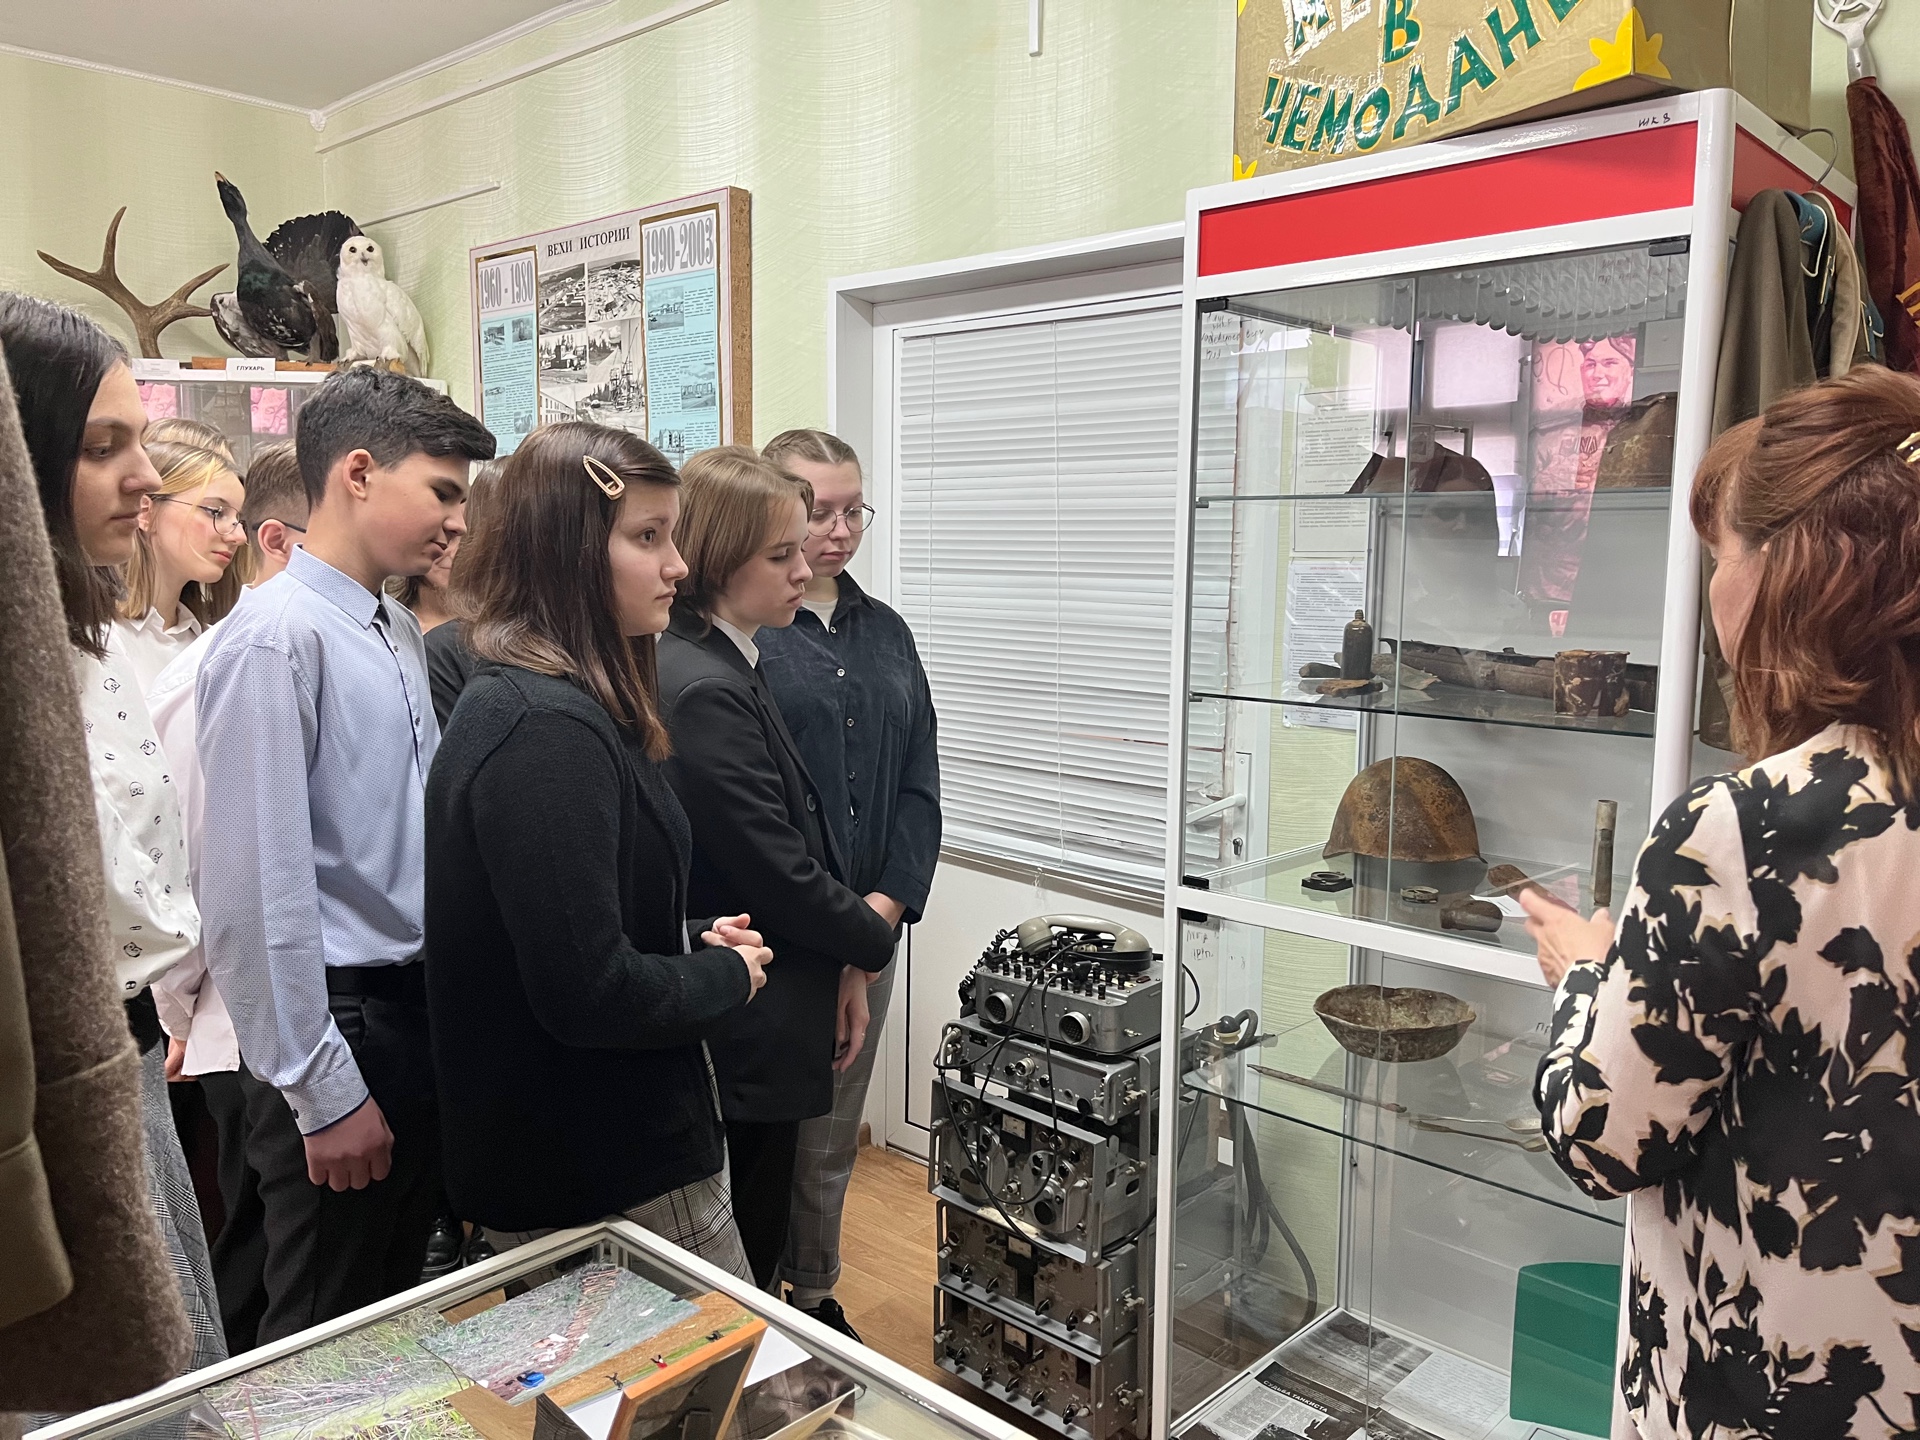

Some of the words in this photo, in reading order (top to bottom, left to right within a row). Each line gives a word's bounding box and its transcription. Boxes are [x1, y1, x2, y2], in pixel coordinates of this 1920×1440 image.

[1382, 0, 1422, 66] В
[1260, 0, 1583, 155] ЧЕМОДАН
[547, 239, 573, 258] ВЕХИ
[579, 226, 631, 250] ИСТОРИИ
[645, 216, 714, 276] 1990-2003
[479, 266, 502, 310] 1960
[510, 260, 535, 305] 1980
[1263, 1380, 1291, 1397] СУДЬБА
[1292, 1393, 1329, 1413] ТАНКИСТА
